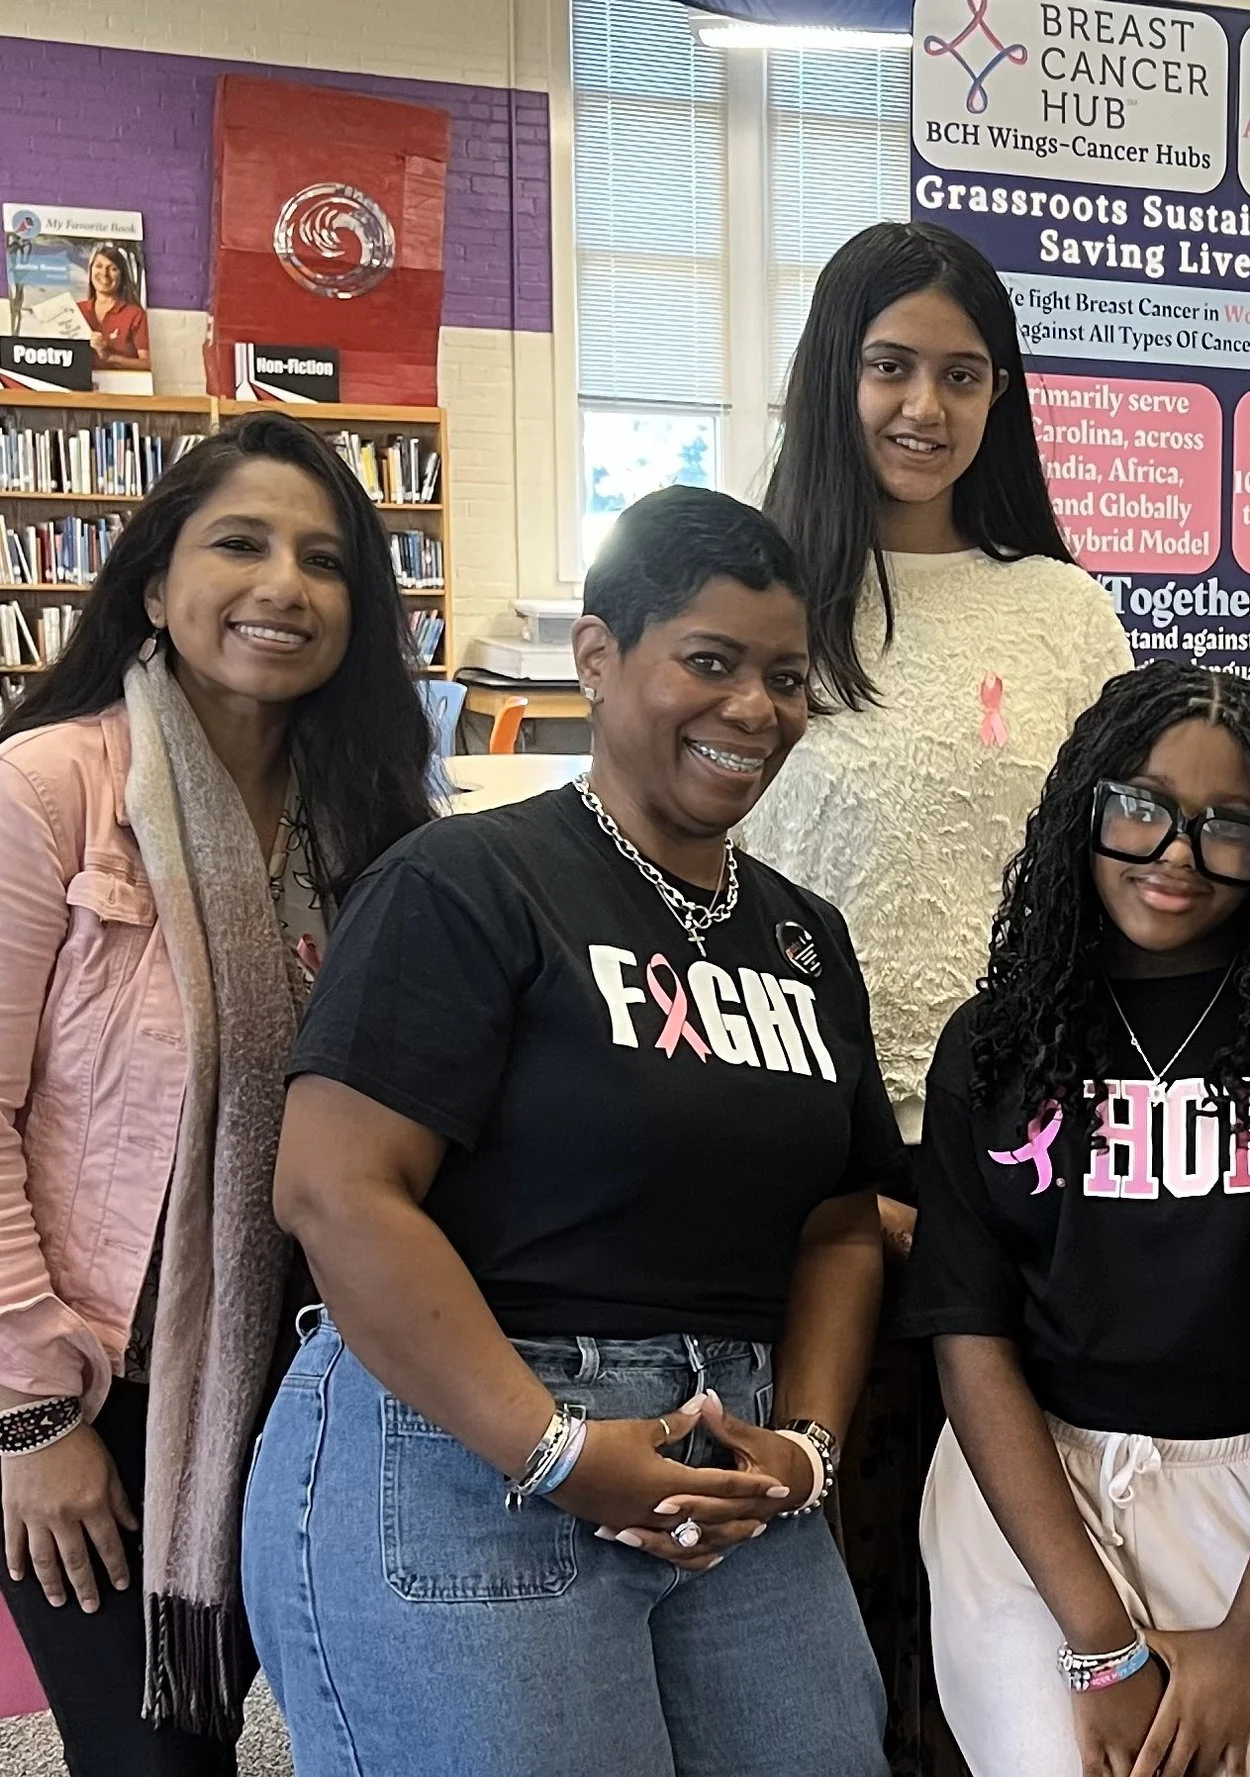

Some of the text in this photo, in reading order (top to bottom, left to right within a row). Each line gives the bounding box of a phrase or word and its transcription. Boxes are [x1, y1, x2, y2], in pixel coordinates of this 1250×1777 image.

[1040, 3, 1196, 52] BREAST
[1040, 47, 1209, 97] CANCER
[1041, 89, 1126, 130] HUB
[926, 121, 980, 146] BCH
[1156, 143, 1211, 169] Hubs
[915, 174, 1128, 226] Grassroots
[45, 218, 137, 234] My Favorite Book
[1040, 228, 1165, 279] Saving
[1009, 287, 1025, 307] e
[1029, 288, 1070, 314] fight
[1076, 293, 1134, 315] Breast
[1138, 298, 1200, 321] Cancer
[1204, 302, 1219, 321] in
[1021, 321, 1085, 344] against
[1089, 324, 1114, 344] All
[1118, 326, 1172, 352] Types
[1176, 330, 1198, 350] Of
[13, 344, 74, 367] Poetry
[256, 357, 334, 377] Non-Fiction
[1028, 384, 1190, 418] rimarily serve
[1134, 429, 1205, 451] across
[1108, 457, 1184, 488] Africa,
[1053, 491, 1192, 528] and Globally
[1139, 529, 1210, 556] Model
[1125, 625, 1179, 650] tand
